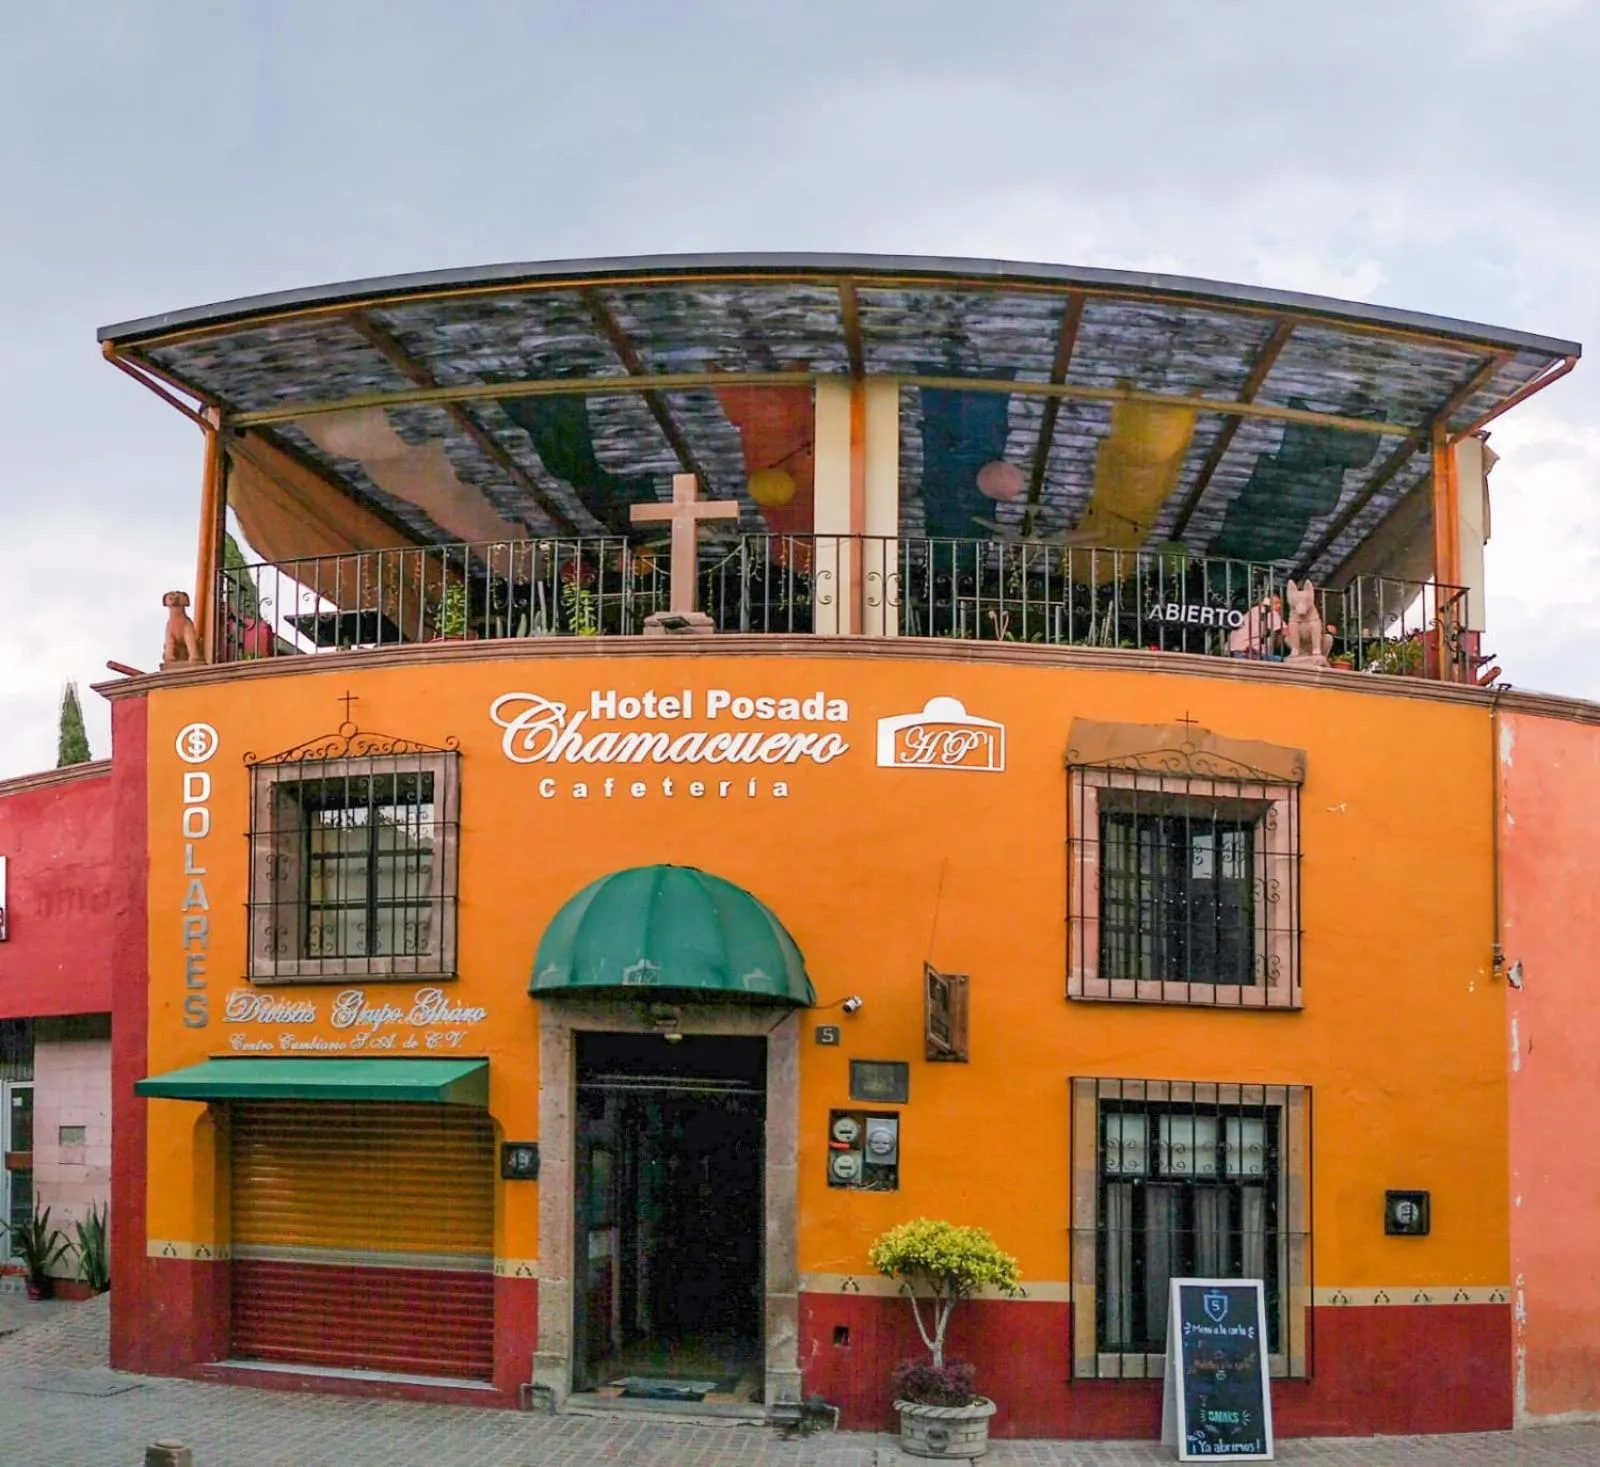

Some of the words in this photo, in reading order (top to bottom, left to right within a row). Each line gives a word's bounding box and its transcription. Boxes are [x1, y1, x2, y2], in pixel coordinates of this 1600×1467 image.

[1148, 603, 1244, 628] ABIERTO
[590, 688, 692, 720] Hotel
[706, 688, 849, 721] Posada
[489, 691, 850, 764] Chamacuero
[538, 776, 789, 798] Cafetería
[181, 771, 212, 1029] DOLARES
[330, 989, 403, 1032] Grupo
[229, 1032, 274, 1051] Centro
[277, 1033, 347, 1051] Cambiario
[403, 1035, 418, 1049] de
[821, 1028, 834, 1043] 5
[1211, 1299, 1221, 1312] 5
